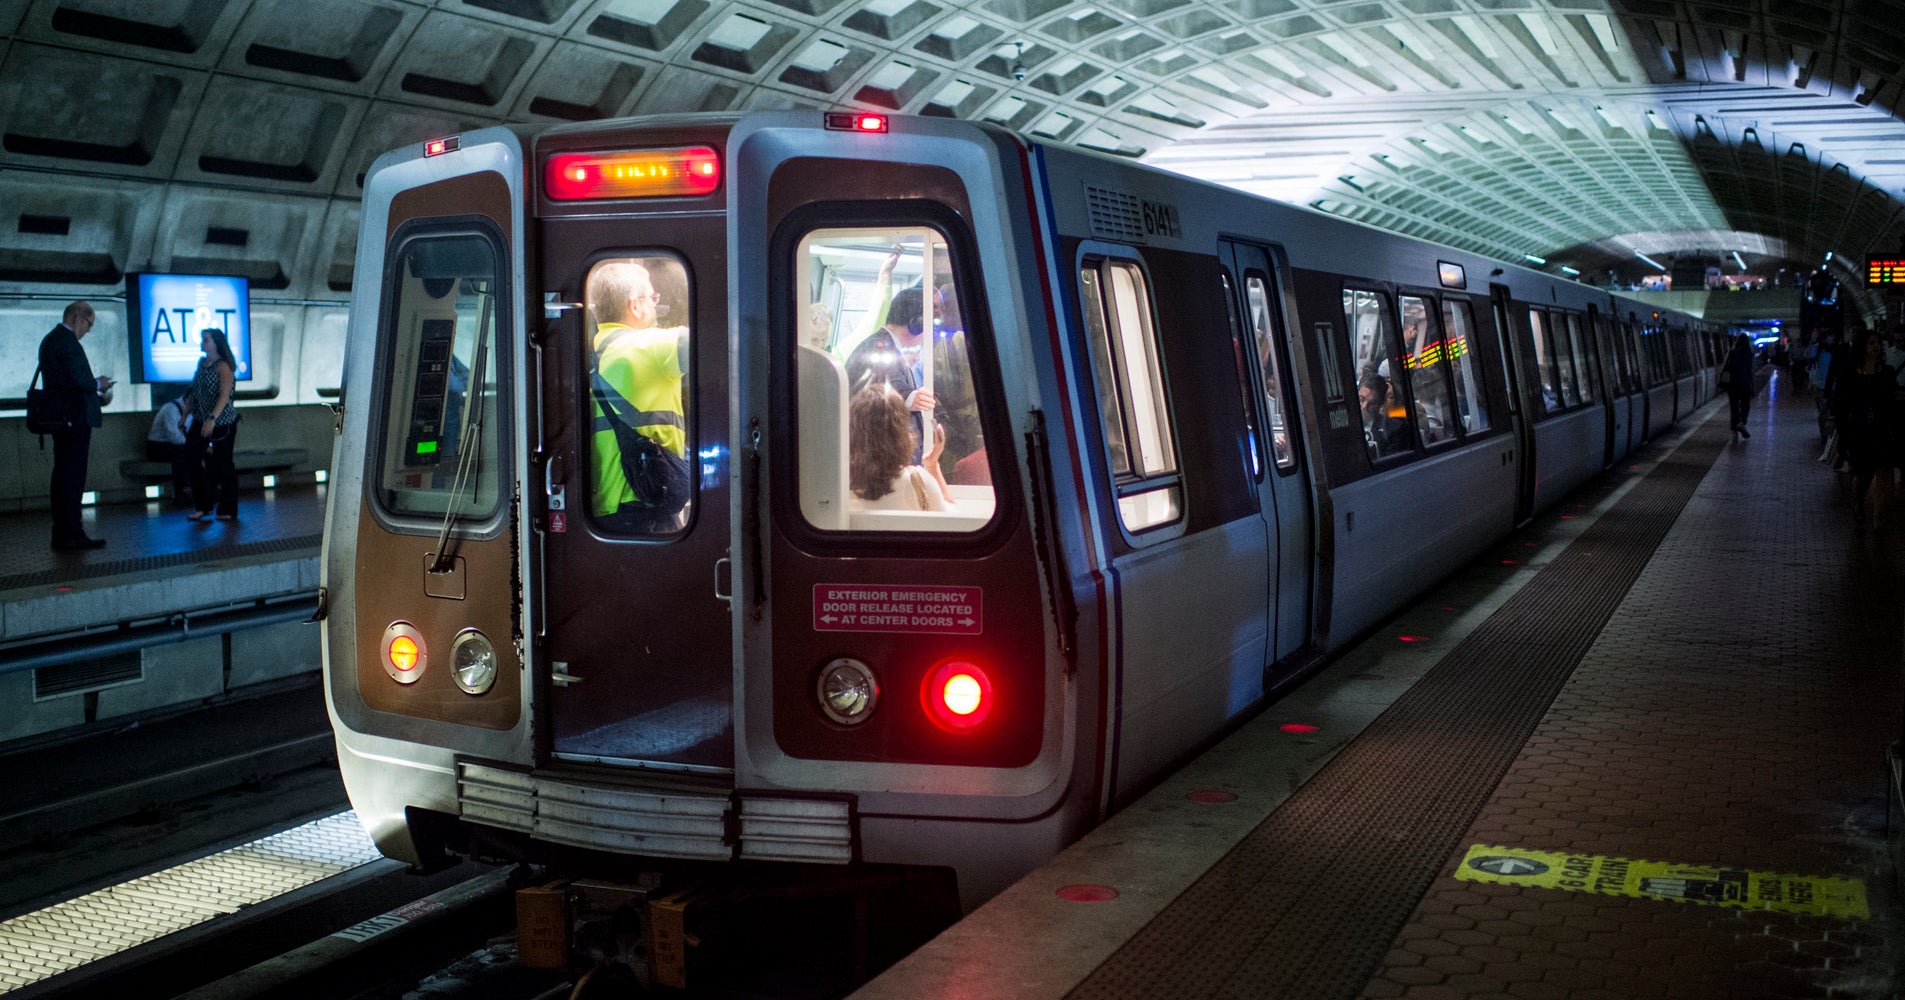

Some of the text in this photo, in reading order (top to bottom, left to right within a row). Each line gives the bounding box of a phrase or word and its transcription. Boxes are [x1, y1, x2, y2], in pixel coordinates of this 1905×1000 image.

[1143, 201, 1173, 237] 6141
[151, 306, 236, 344] AT&T
[828, 590, 967, 602] EXTERIOR EMERGENCY
[823, 602, 973, 615] DOOR RELEASE LOCATED
[841, 615, 953, 627] AT CENTER DOORS
[1561, 857, 1594, 879] CAR
[1594, 857, 1630, 892] TRAIN
